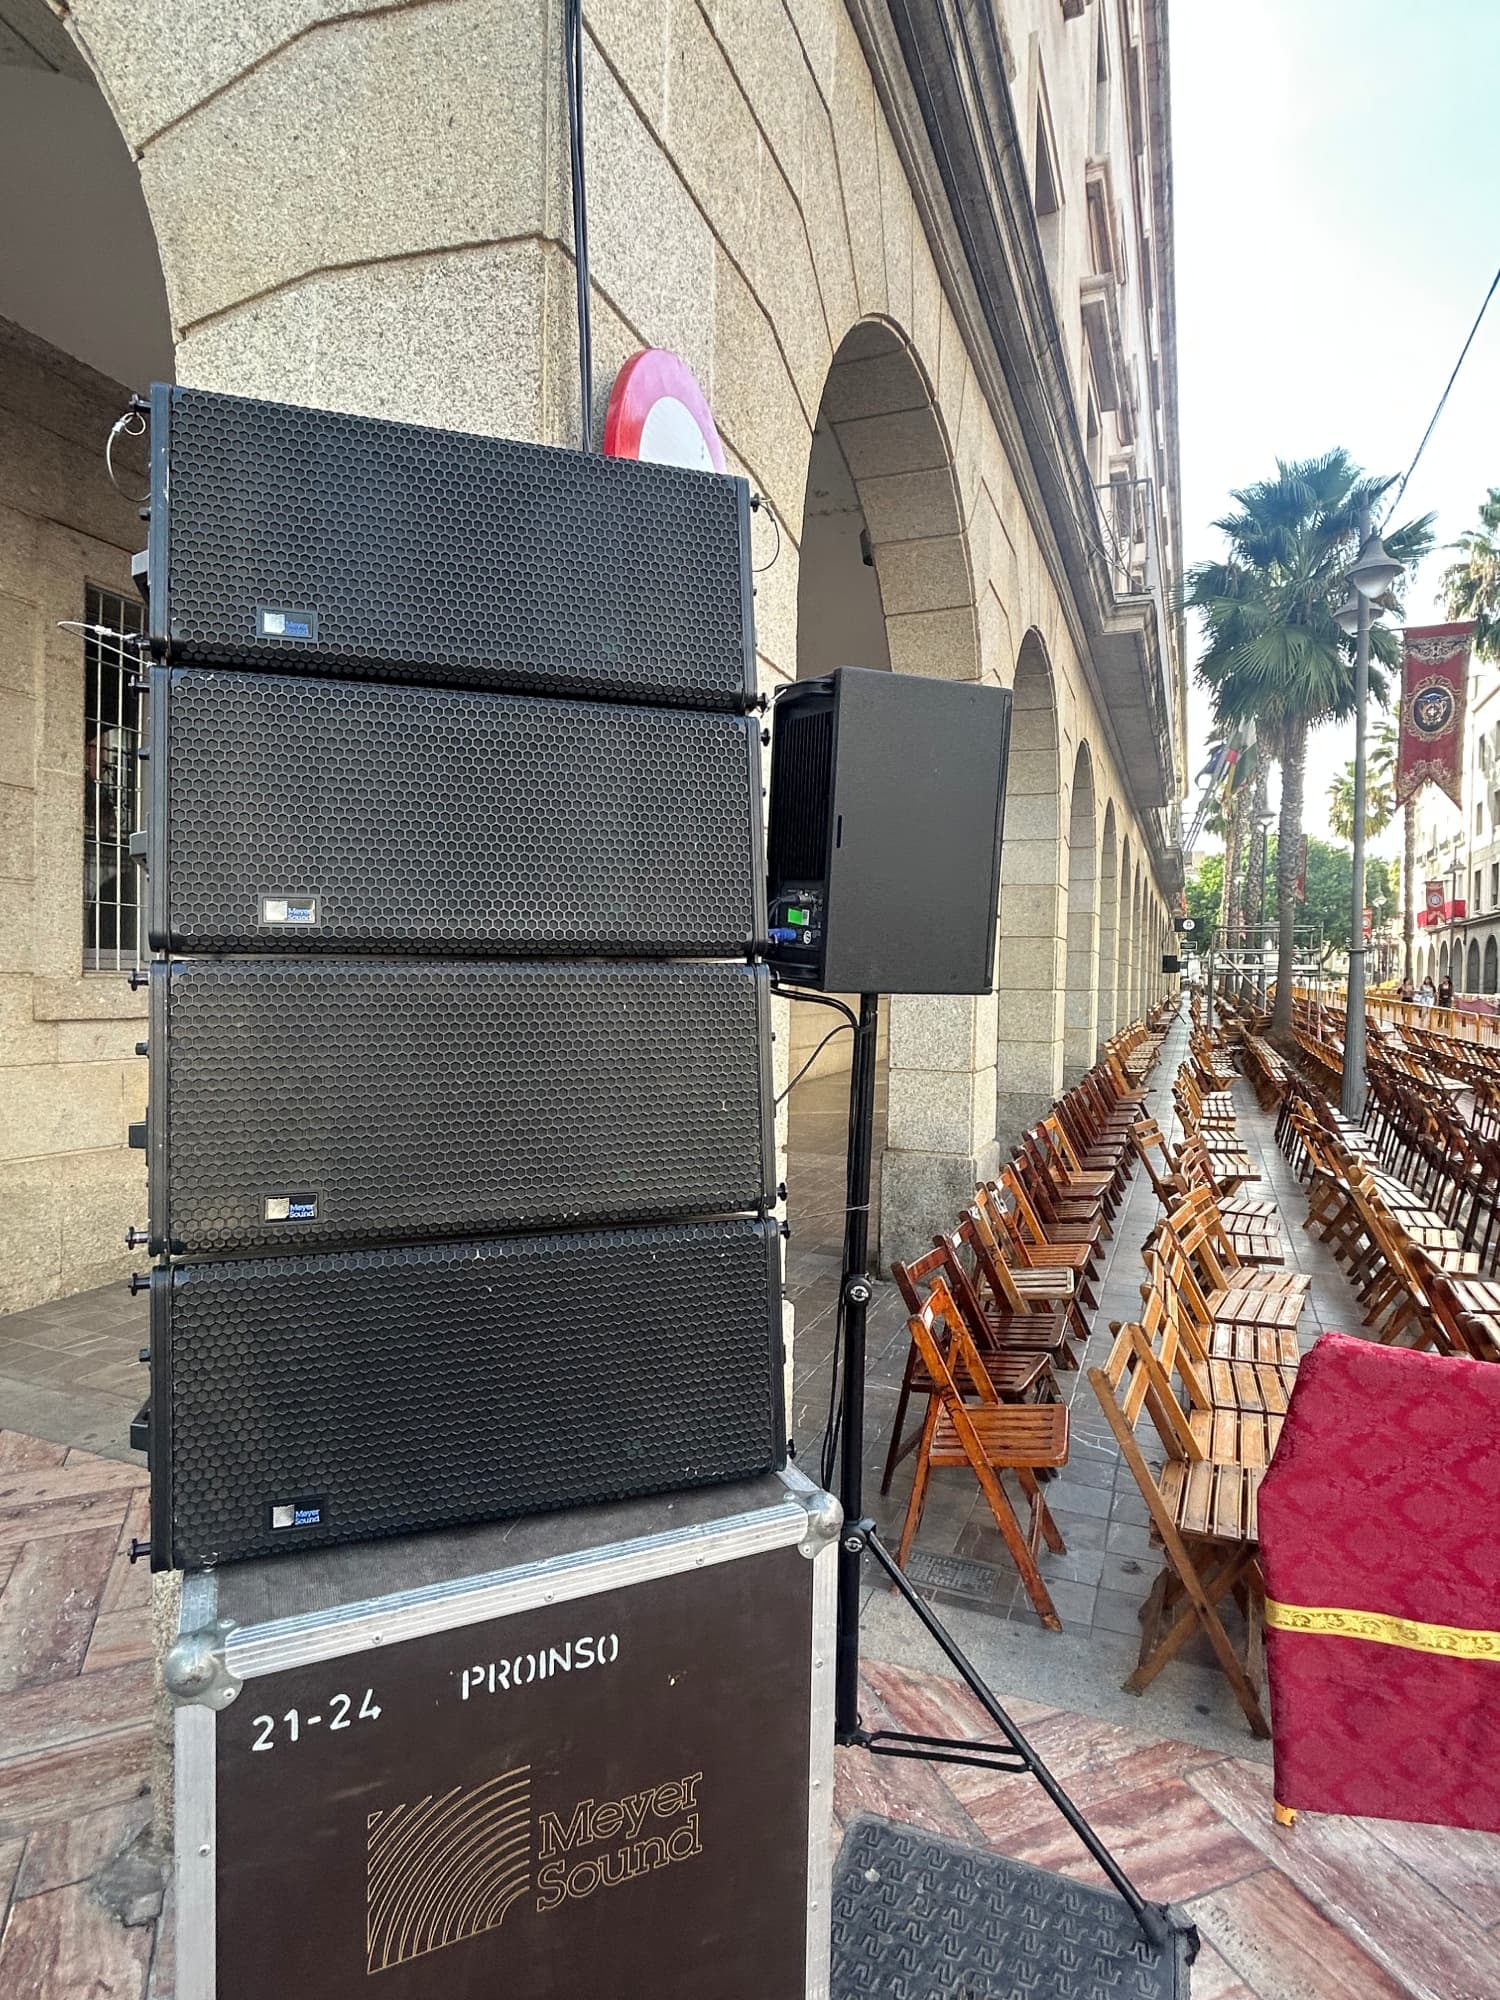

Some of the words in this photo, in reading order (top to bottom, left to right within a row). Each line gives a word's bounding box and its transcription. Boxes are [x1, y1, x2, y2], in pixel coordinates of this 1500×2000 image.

[290, 1204, 314, 1212] Meyer
[290, 1210, 314, 1218] Sound
[295, 1509, 320, 1518] Meyer
[295, 1516, 320, 1525] Sound
[462, 1633, 619, 1700] PROINSO
[251, 1688, 382, 1751] 21-24
[538, 1771, 703, 1860] Meyer
[536, 1812, 703, 1912] Sound
